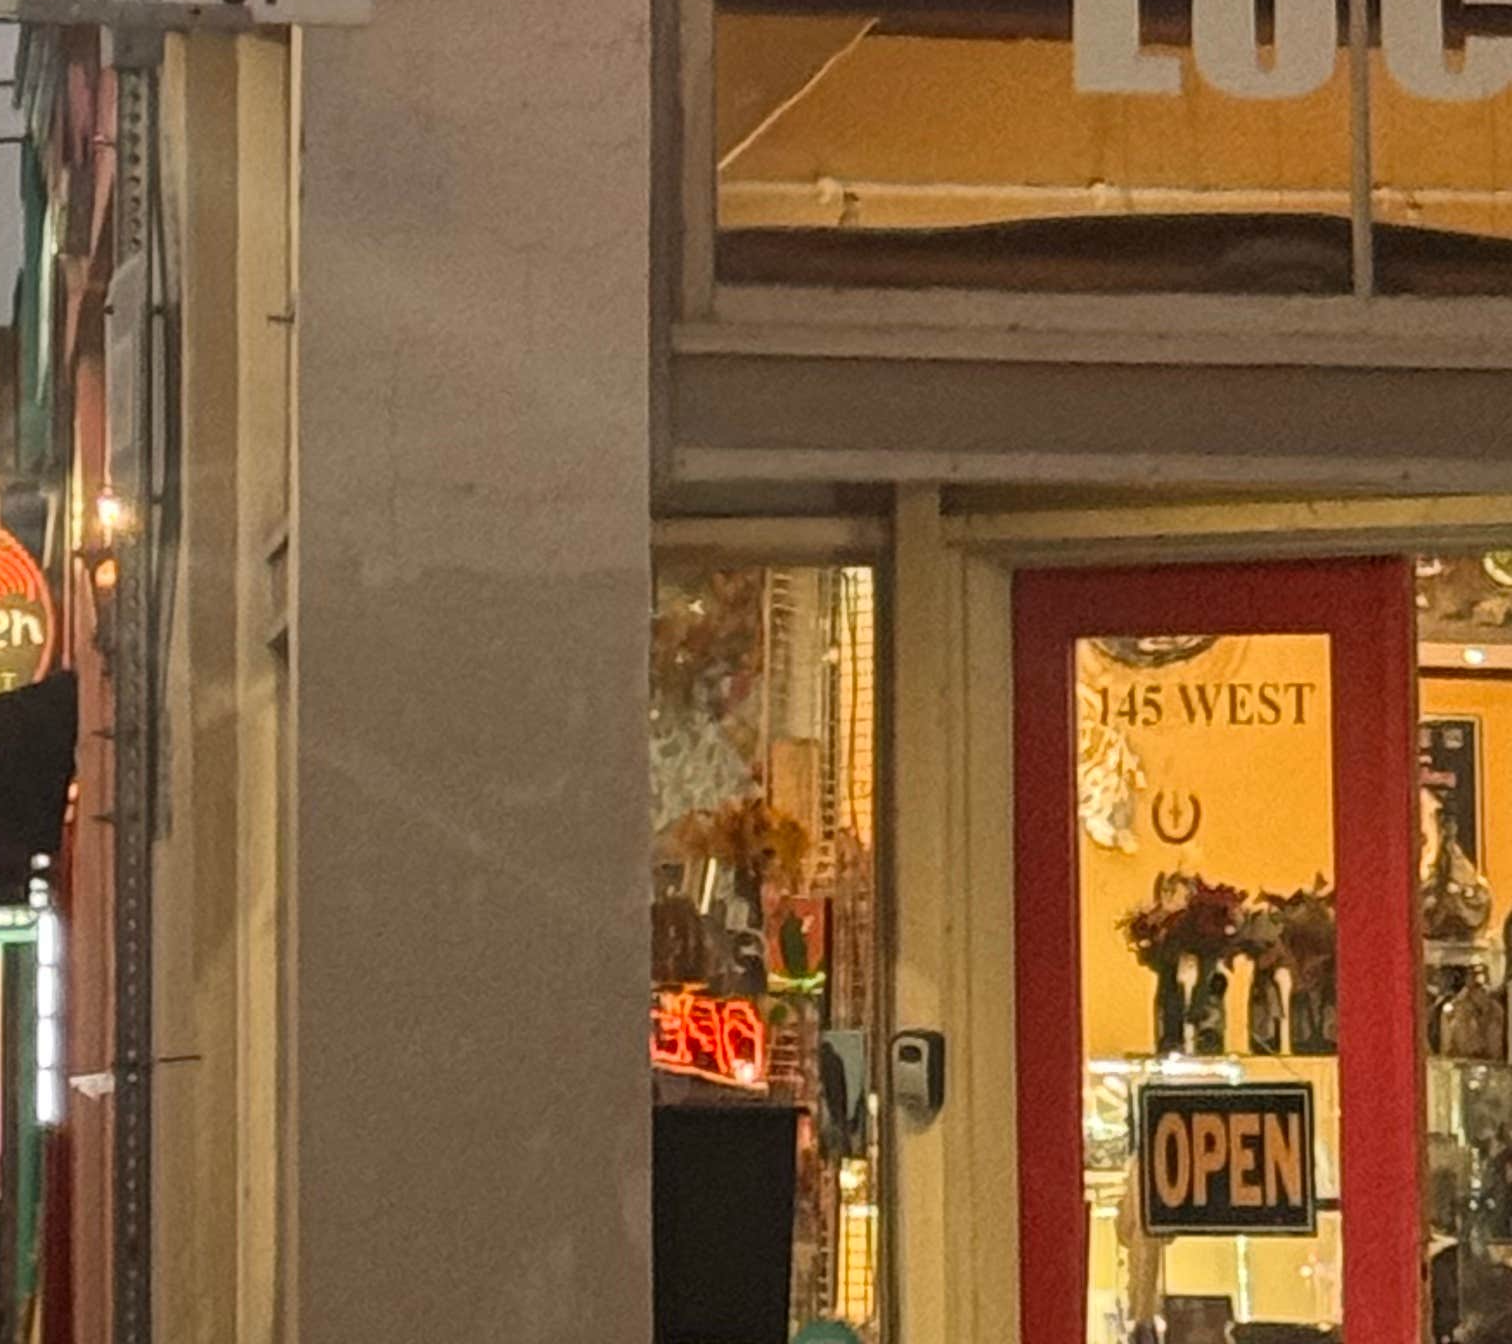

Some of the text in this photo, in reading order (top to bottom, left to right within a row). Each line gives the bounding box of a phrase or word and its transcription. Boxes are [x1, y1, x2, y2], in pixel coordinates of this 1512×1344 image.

[1098, 681, 1317, 727] 145 WEST
[1154, 1112, 1302, 1207] OPEN
